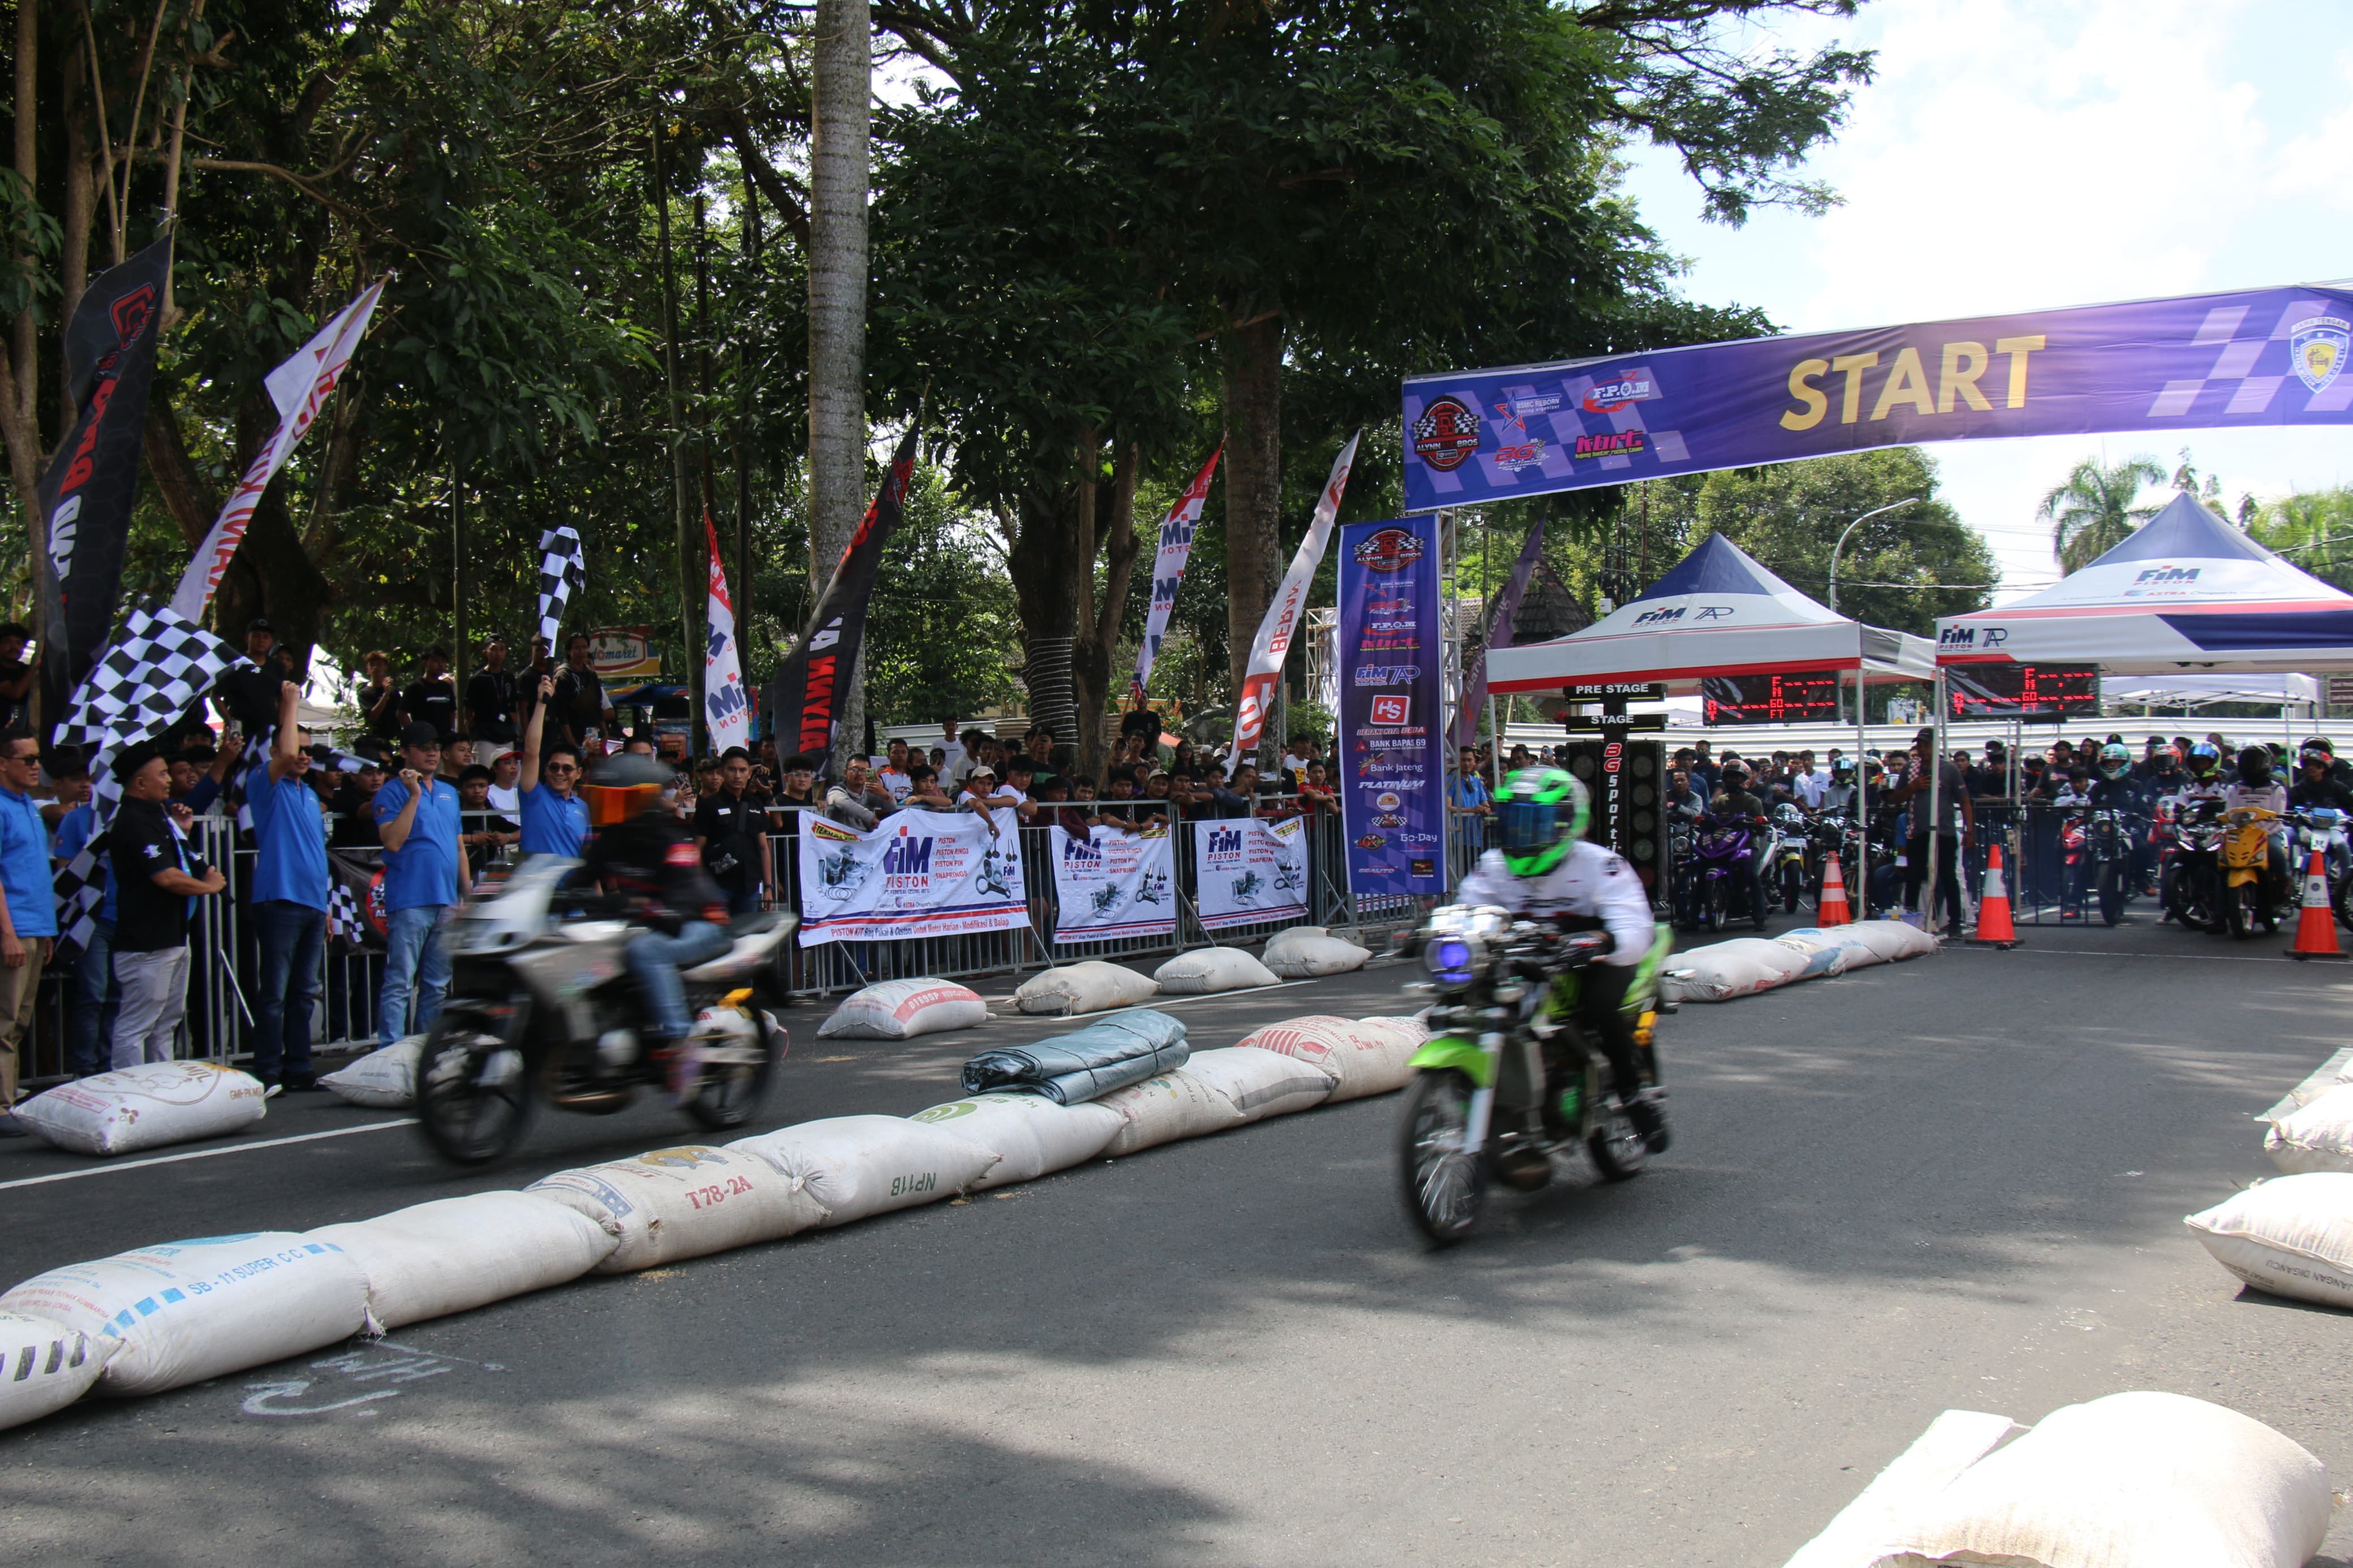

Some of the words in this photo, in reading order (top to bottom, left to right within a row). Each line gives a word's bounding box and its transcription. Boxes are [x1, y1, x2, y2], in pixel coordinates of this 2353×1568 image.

[1779, 335, 2046, 431] START
[1516, 399, 1534, 409] BSMC
[1535, 397, 1560, 407] REBORN
[1416, 443, 1441, 452] ALYNN
[1457, 438, 1479, 448] BROS
[1576, 685, 1602, 694] PRE
[1606, 684, 1649, 693] STAGE
[1591, 715, 1634, 724] STAGE
[1370, 740, 1390, 748] BANK
[1371, 763, 1394, 772] Bank
[1395, 763, 1423, 773] Jateng
[1358, 779, 1425, 791] PLATINUM
[1400, 833, 1437, 842] Go-Day
[1208, 852, 1240, 861] PISTON
[1065, 861, 1101, 869] PISTON
[935, 870, 968, 879] SNAPRINGS
[831, 927, 854, 938] PISTON
[854, 927, 864, 936] KIT
[913, 924, 927, 934] Untuk
[928, 923, 942, 933] Motor
[942, 922, 959, 932] Harian
[962, 919, 988, 928] Modifikasi
[988, 918, 993, 927] &
[994, 917, 1009, 928] Balap
[685, 1175, 753, 1210] T78-2A
[188, 1281, 213, 1295] SB
[218, 1272, 236, 1284] 11
[232, 1258, 279, 1279] SUPER
[2312, 1272, 2351, 1291] JANGAN
